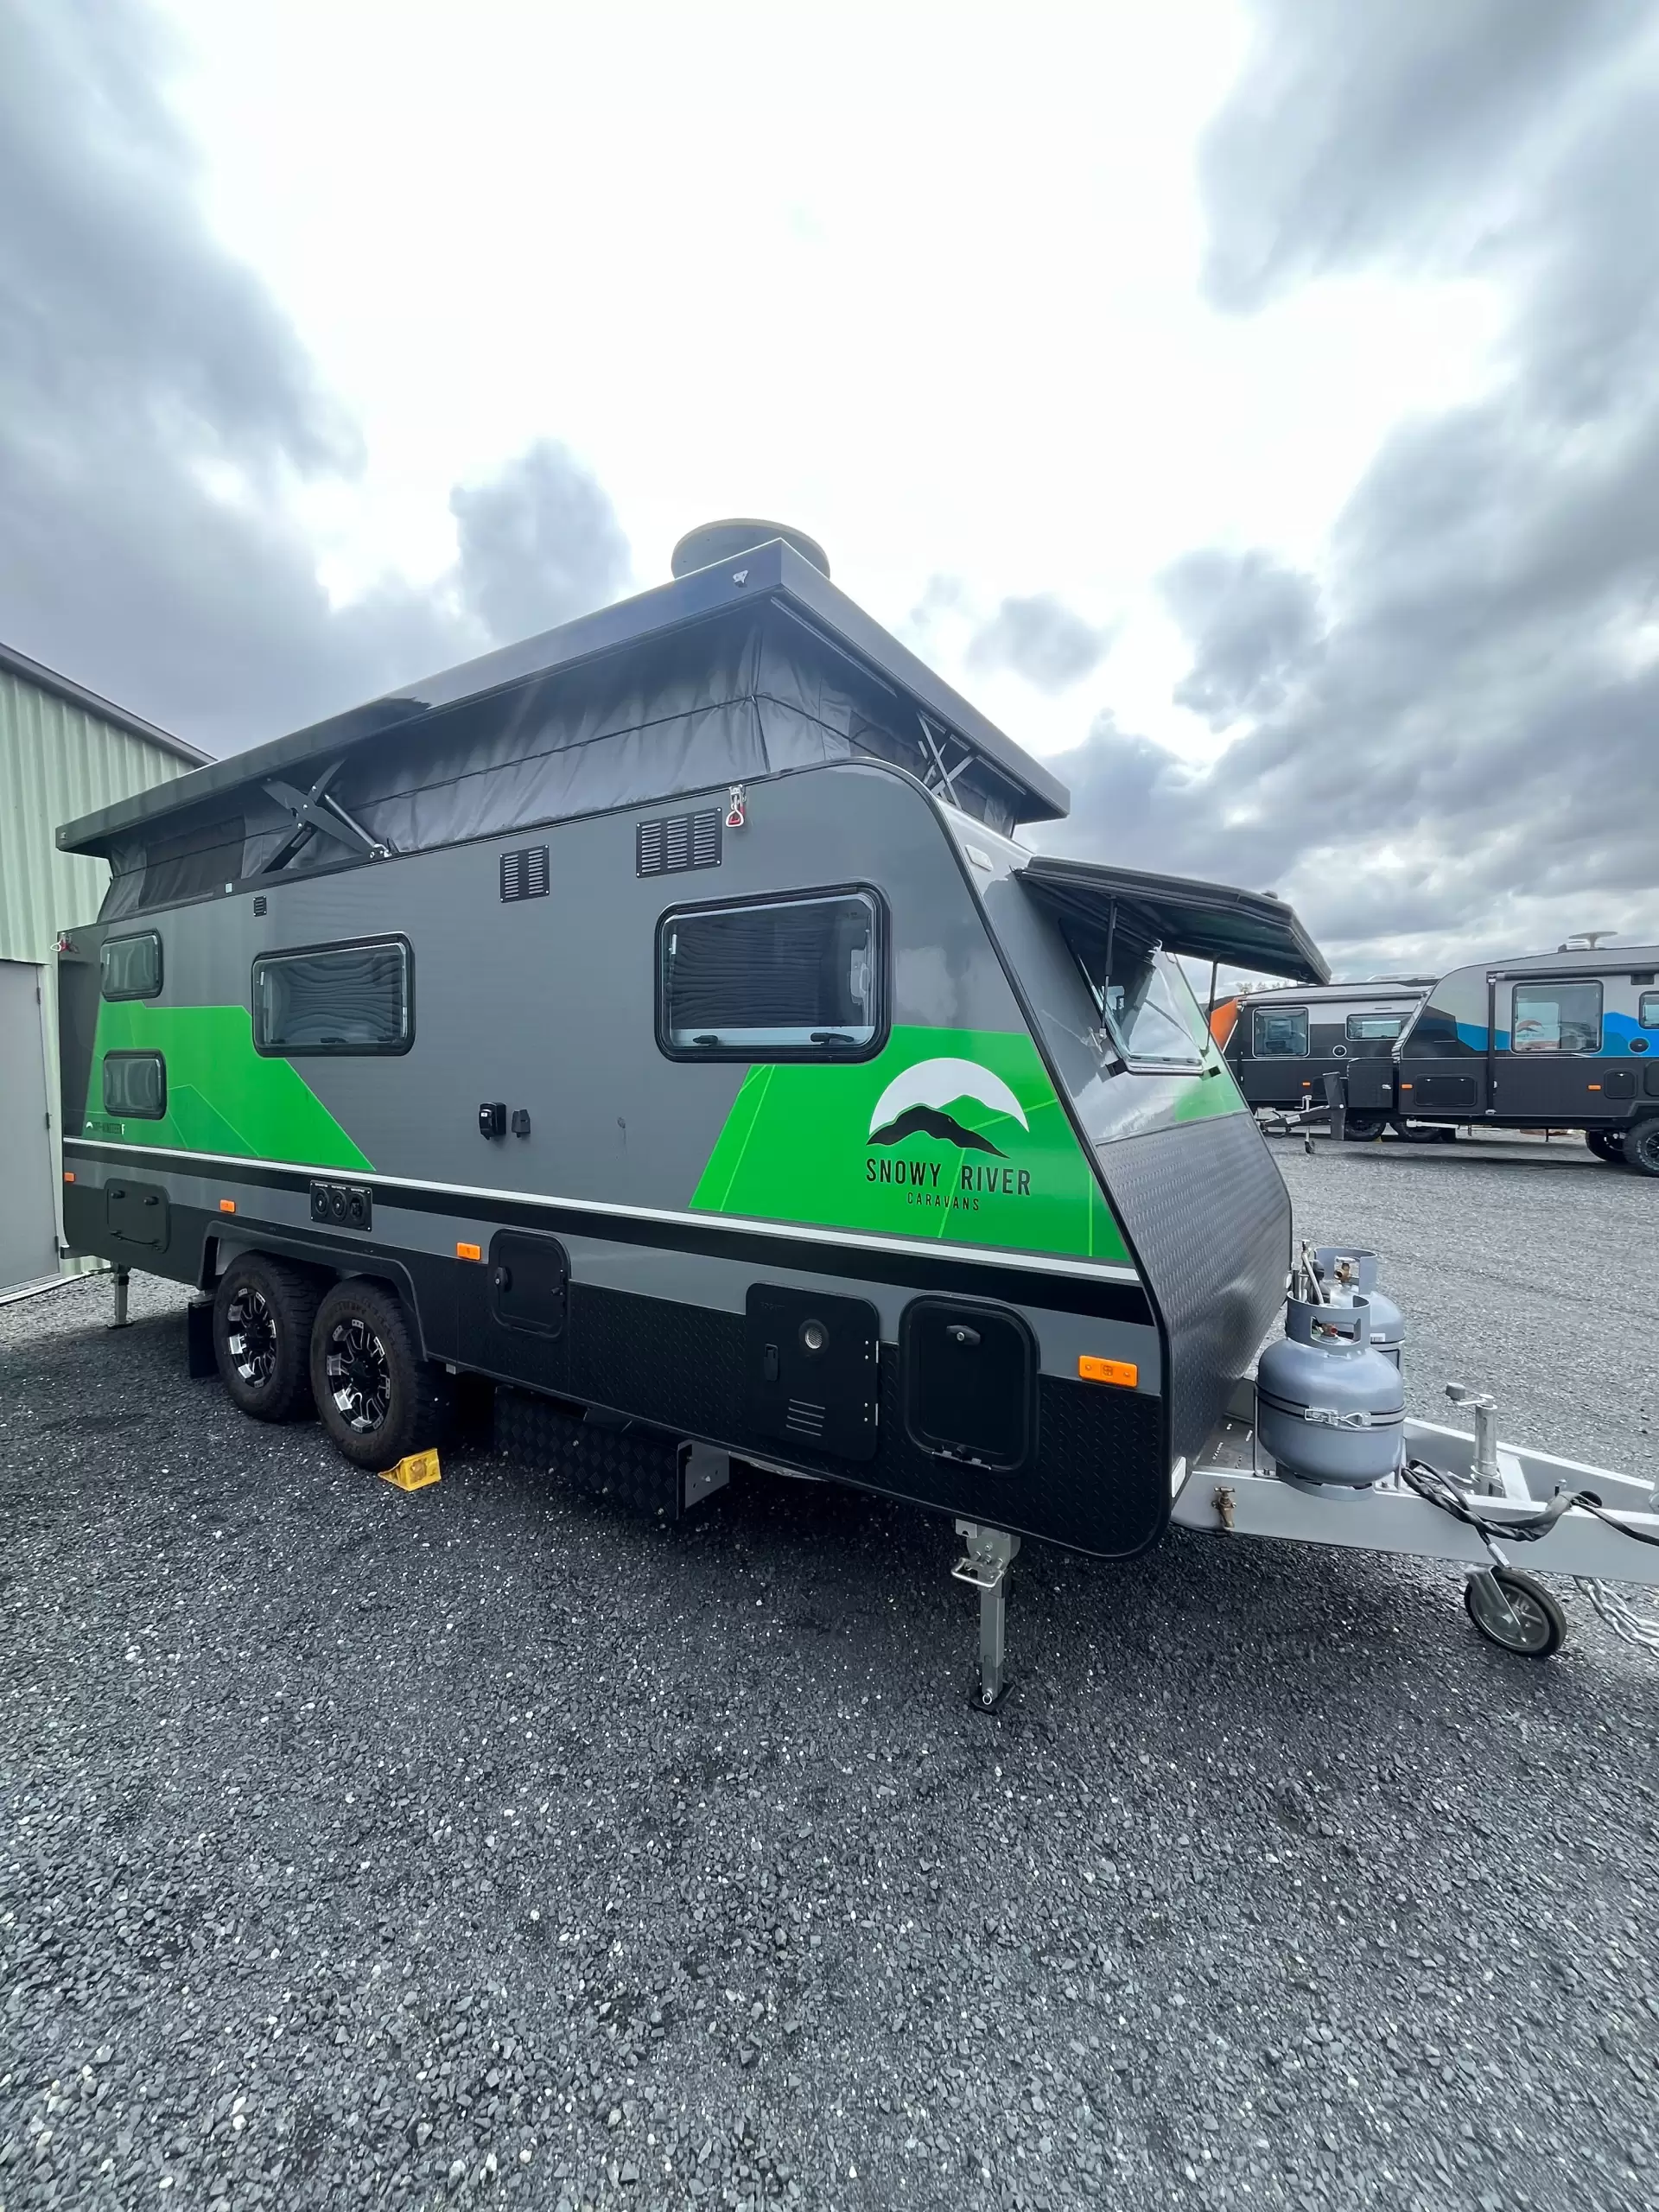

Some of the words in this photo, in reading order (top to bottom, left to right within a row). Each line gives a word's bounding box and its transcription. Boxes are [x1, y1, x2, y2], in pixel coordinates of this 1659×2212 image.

[866, 1158, 942, 1187] SNOWY
[961, 1165, 1031, 1196] RIVER
[907, 1192, 979, 1211] CARAVANS
